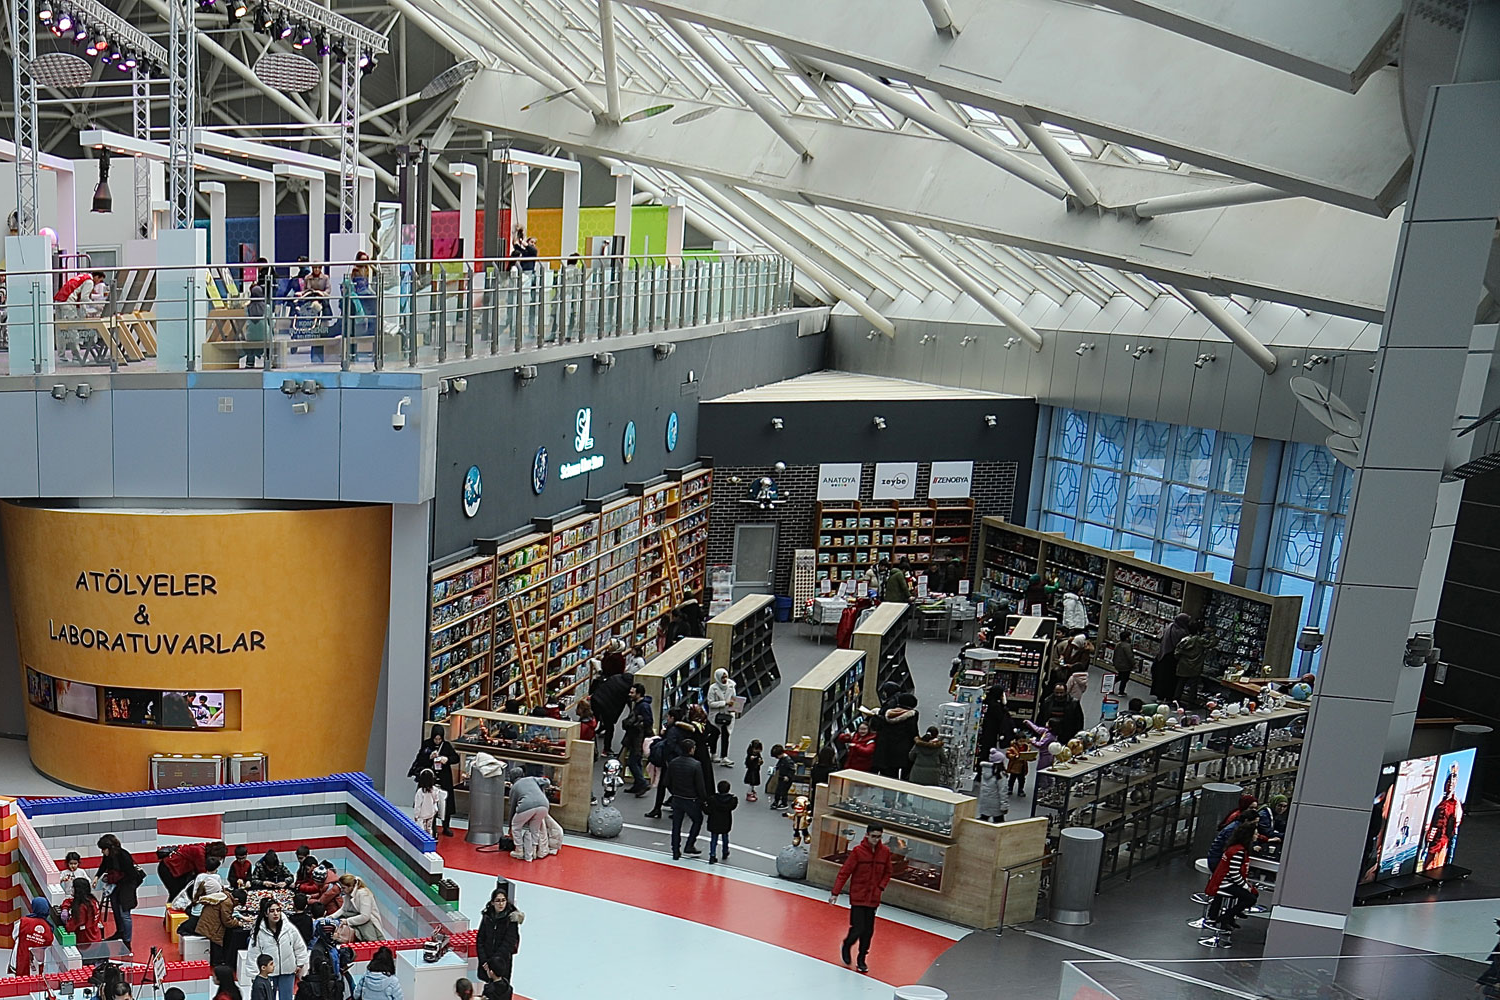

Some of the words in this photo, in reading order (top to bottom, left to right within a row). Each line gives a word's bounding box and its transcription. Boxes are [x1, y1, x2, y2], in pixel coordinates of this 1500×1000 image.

[822, 476, 856, 484] ANATOYA
[75, 568, 218, 596] ATÖLYELER
[133, 604, 150, 625] &
[49, 619, 267, 655] LABORATUVARLAR
